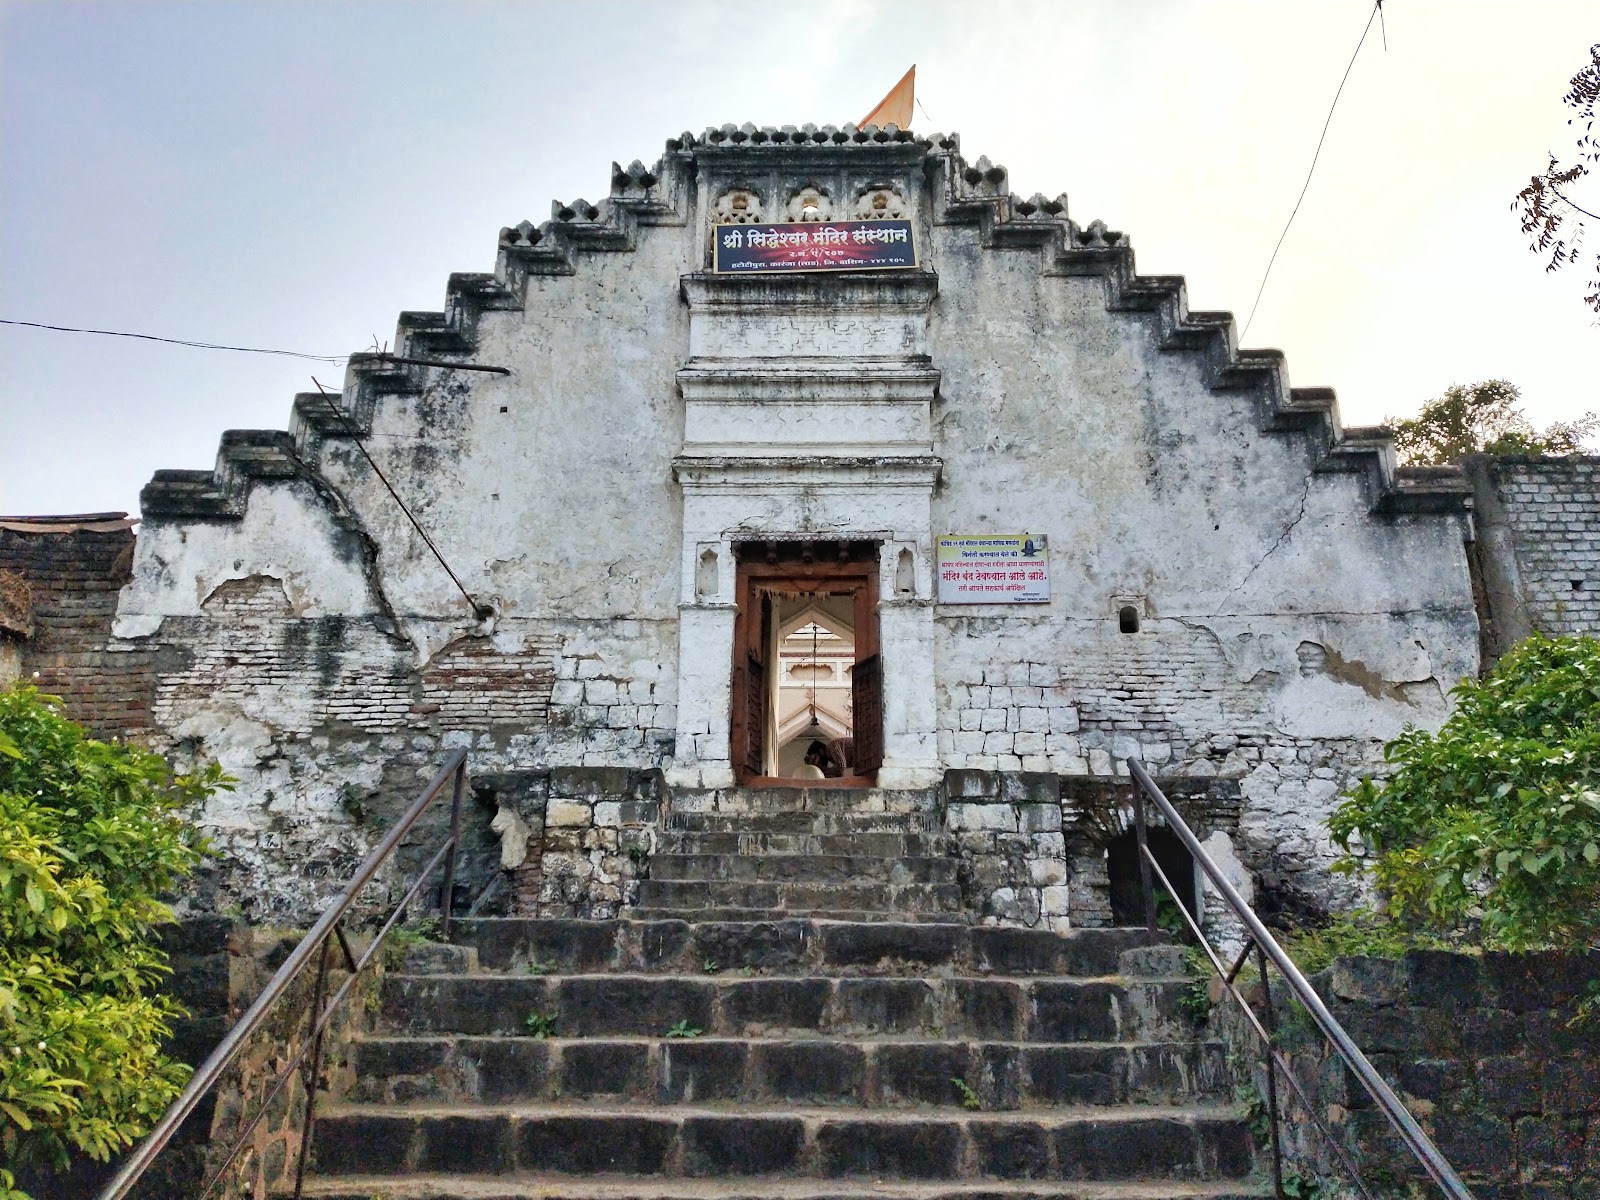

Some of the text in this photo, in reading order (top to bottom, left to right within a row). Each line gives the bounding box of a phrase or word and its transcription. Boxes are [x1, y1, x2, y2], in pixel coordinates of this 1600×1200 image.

[723, 225, 907, 249] श्री सिद्धेश्वर मंदिर संस्थान
[943, 568, 1047, 582] मंदिर बंद ठेवण्यात आले आहे.
